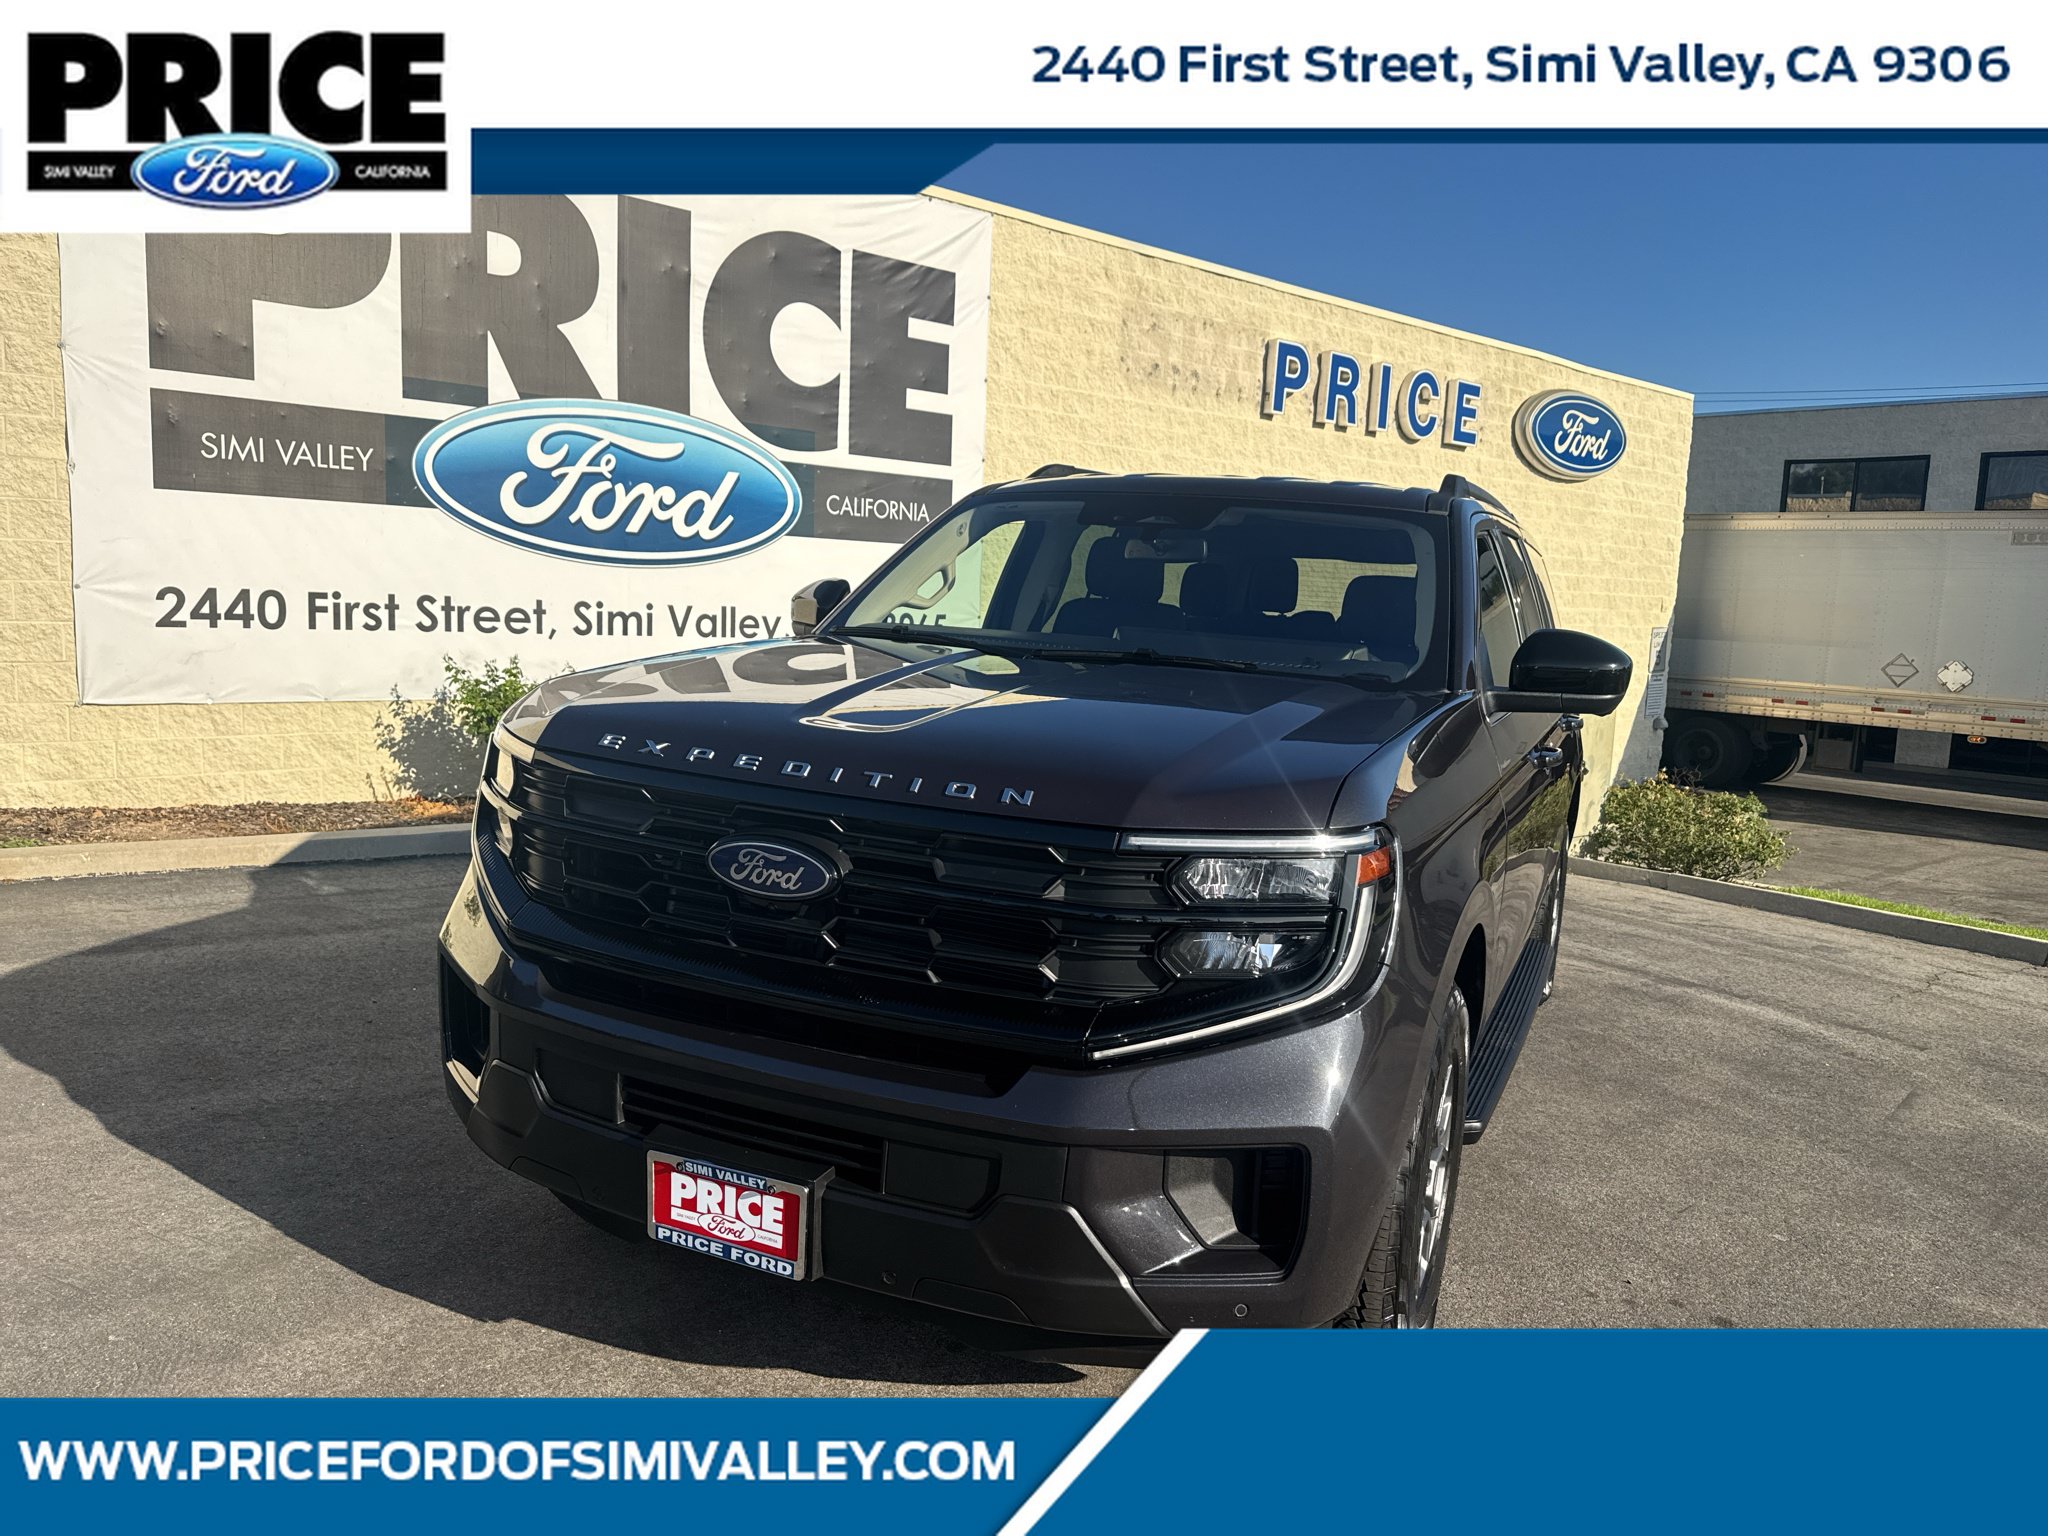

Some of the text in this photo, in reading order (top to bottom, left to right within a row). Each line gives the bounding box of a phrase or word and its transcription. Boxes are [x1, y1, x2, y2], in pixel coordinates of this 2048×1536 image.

[1264, 339, 1482, 447] PRICE
[200, 432, 374, 471] SIMI VALLEY
[1554, 409, 1612, 460] Ford
[500, 422, 735, 541] Ford
[826, 495, 931, 522] CALIFORNIA
[156, 586, 287, 630] 2440
[308, 591, 400, 631] First
[415, 595, 557, 639] Street,
[573, 601, 654, 636] Simi
[597, 733, 1035, 807] EXPEDITION
[730, 848, 805, 890] Ford
[685, 1161, 766, 1189] SIMI VALLEY
[671, 1172, 784, 1234] PRICE
[707, 1215, 746, 1240] Ford
[657, 1227, 793, 1275] PRICE FORD
